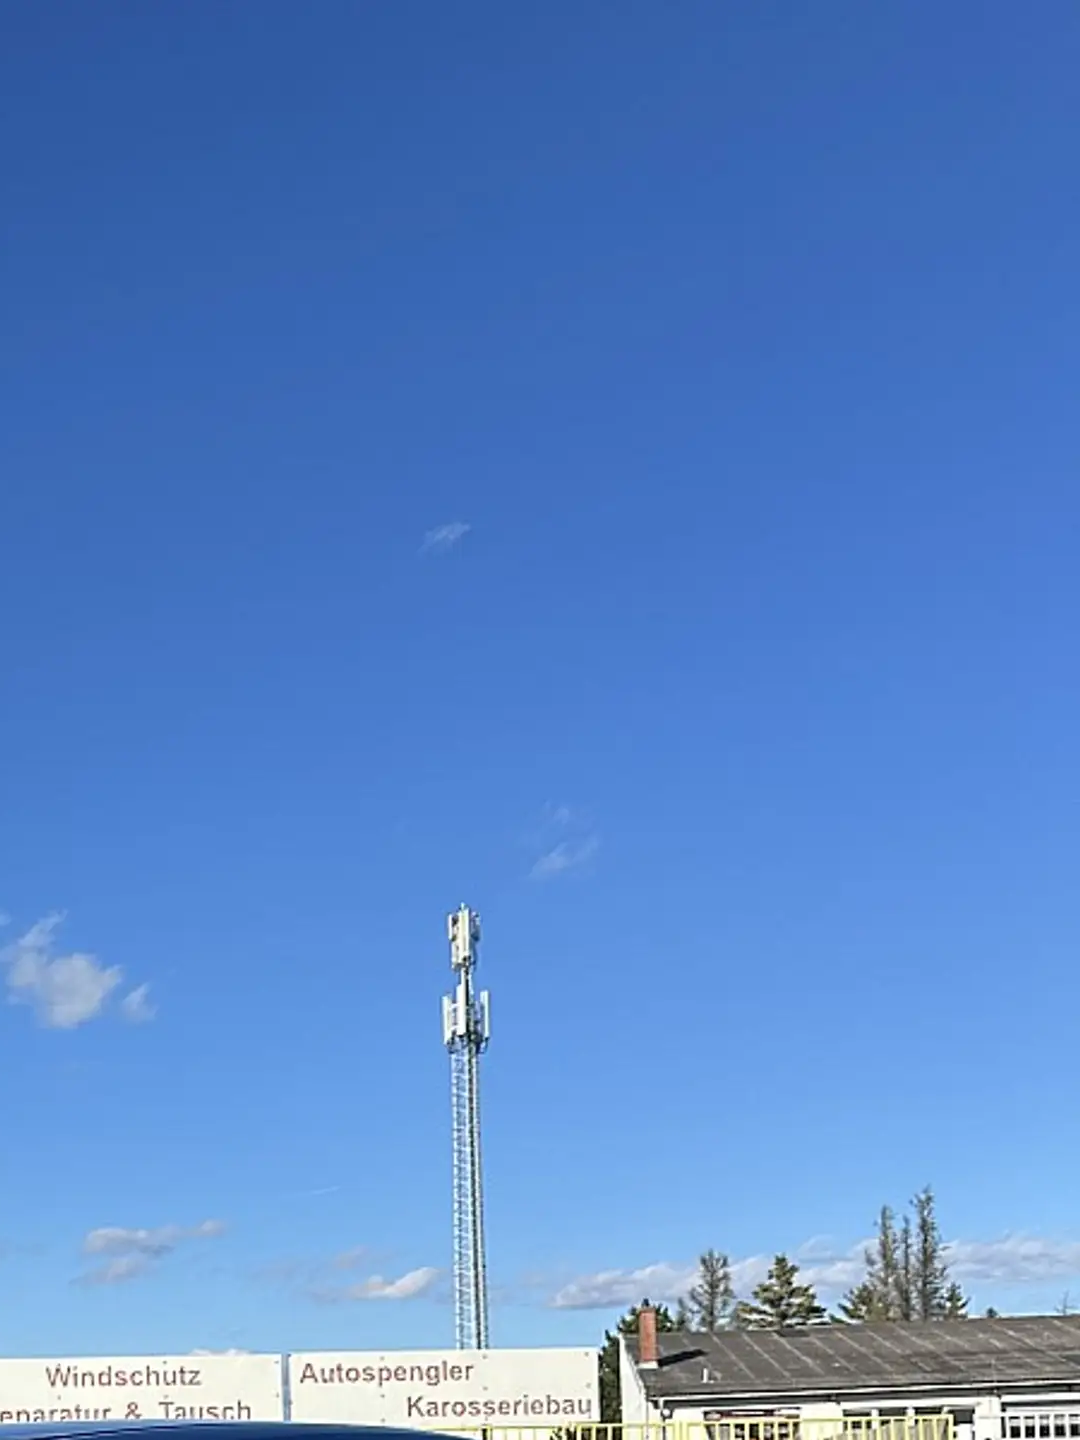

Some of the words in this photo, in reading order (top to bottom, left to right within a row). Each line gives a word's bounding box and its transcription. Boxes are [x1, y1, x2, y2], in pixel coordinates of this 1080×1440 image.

[46, 1365, 202, 1387] Windschutz
[300, 1361, 473, 1386] Autospengler
[124, 1402, 142, 1420] &
[159, 1400, 252, 1420] Tausch
[407, 1395, 592, 1418] Karosseriebau
